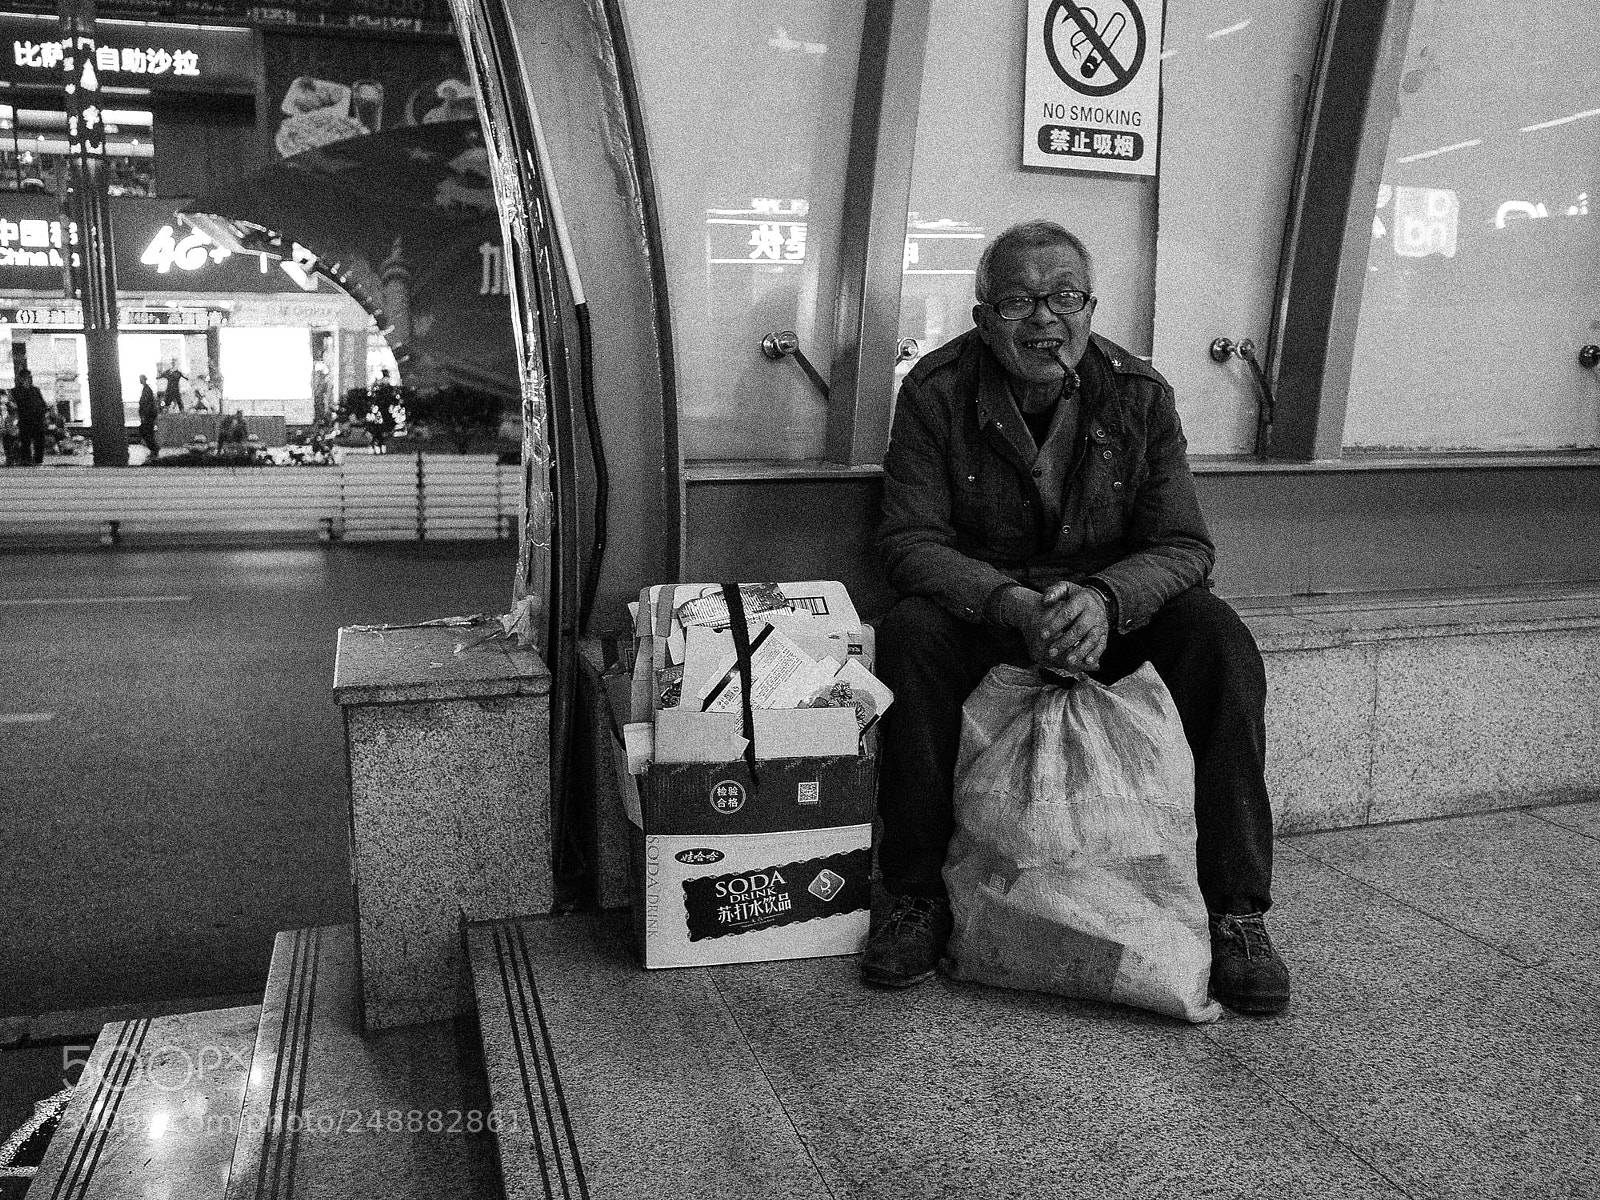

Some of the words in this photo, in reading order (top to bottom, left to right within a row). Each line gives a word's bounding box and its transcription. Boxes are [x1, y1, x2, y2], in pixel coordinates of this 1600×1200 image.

[1043, 102, 1065, 119] NO
[1070, 105, 1142, 127] SMOKING
[1049, 128, 1135, 157] 禁止吸烟
[716, 785, 739, 797] 检验
[716, 797, 739, 808] 合格
[647, 835, 660, 889] SODA
[680, 850, 719, 863] 娃哈哈
[715, 870, 787, 898] SODA
[729, 886, 778, 904] DRINK
[647, 894, 660, 938] DRINK
[716, 892, 792, 924] 苏打水饮品
